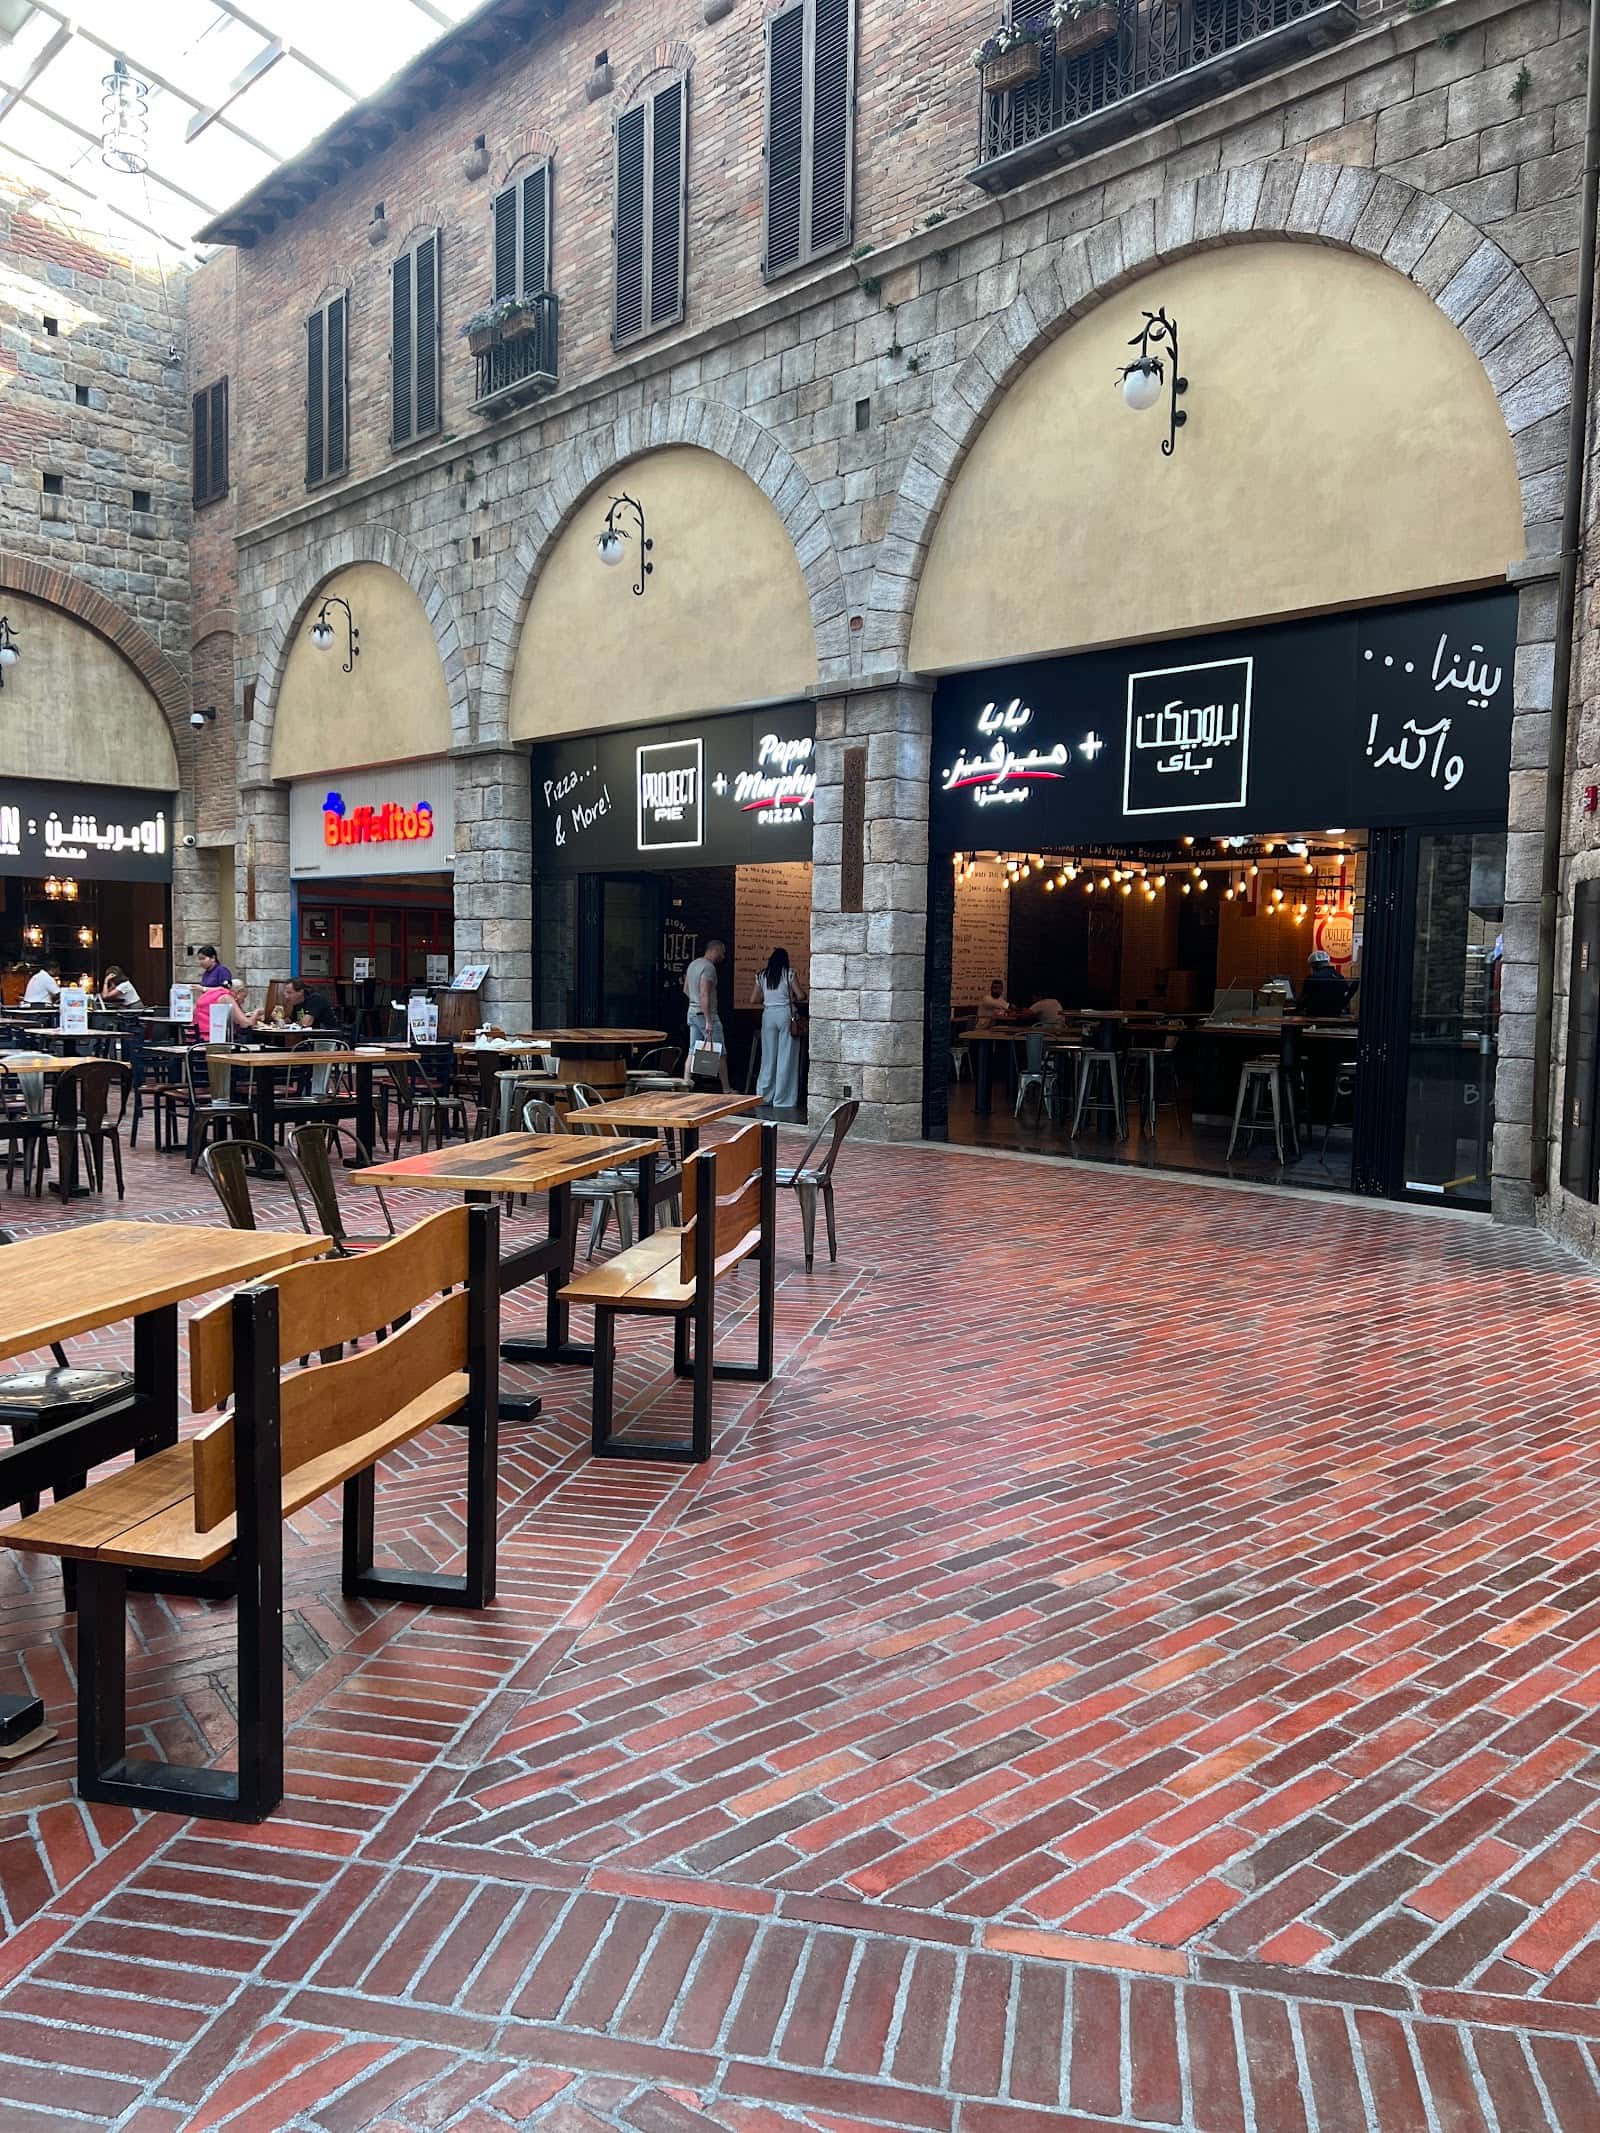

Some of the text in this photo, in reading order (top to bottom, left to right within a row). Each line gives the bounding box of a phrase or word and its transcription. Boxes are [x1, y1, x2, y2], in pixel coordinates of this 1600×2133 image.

[1136, 700, 1239, 750] بروجيكت
[758, 734, 813, 773] Papa
[642, 766, 697, 809] PROJECT
[734, 764, 818, 808] Murphy
[571, 783, 613, 833] More!
[654, 806, 685, 822] PIE
[758, 807, 805, 825] PIZZA
[1190, 847, 1216, 857] Texas
